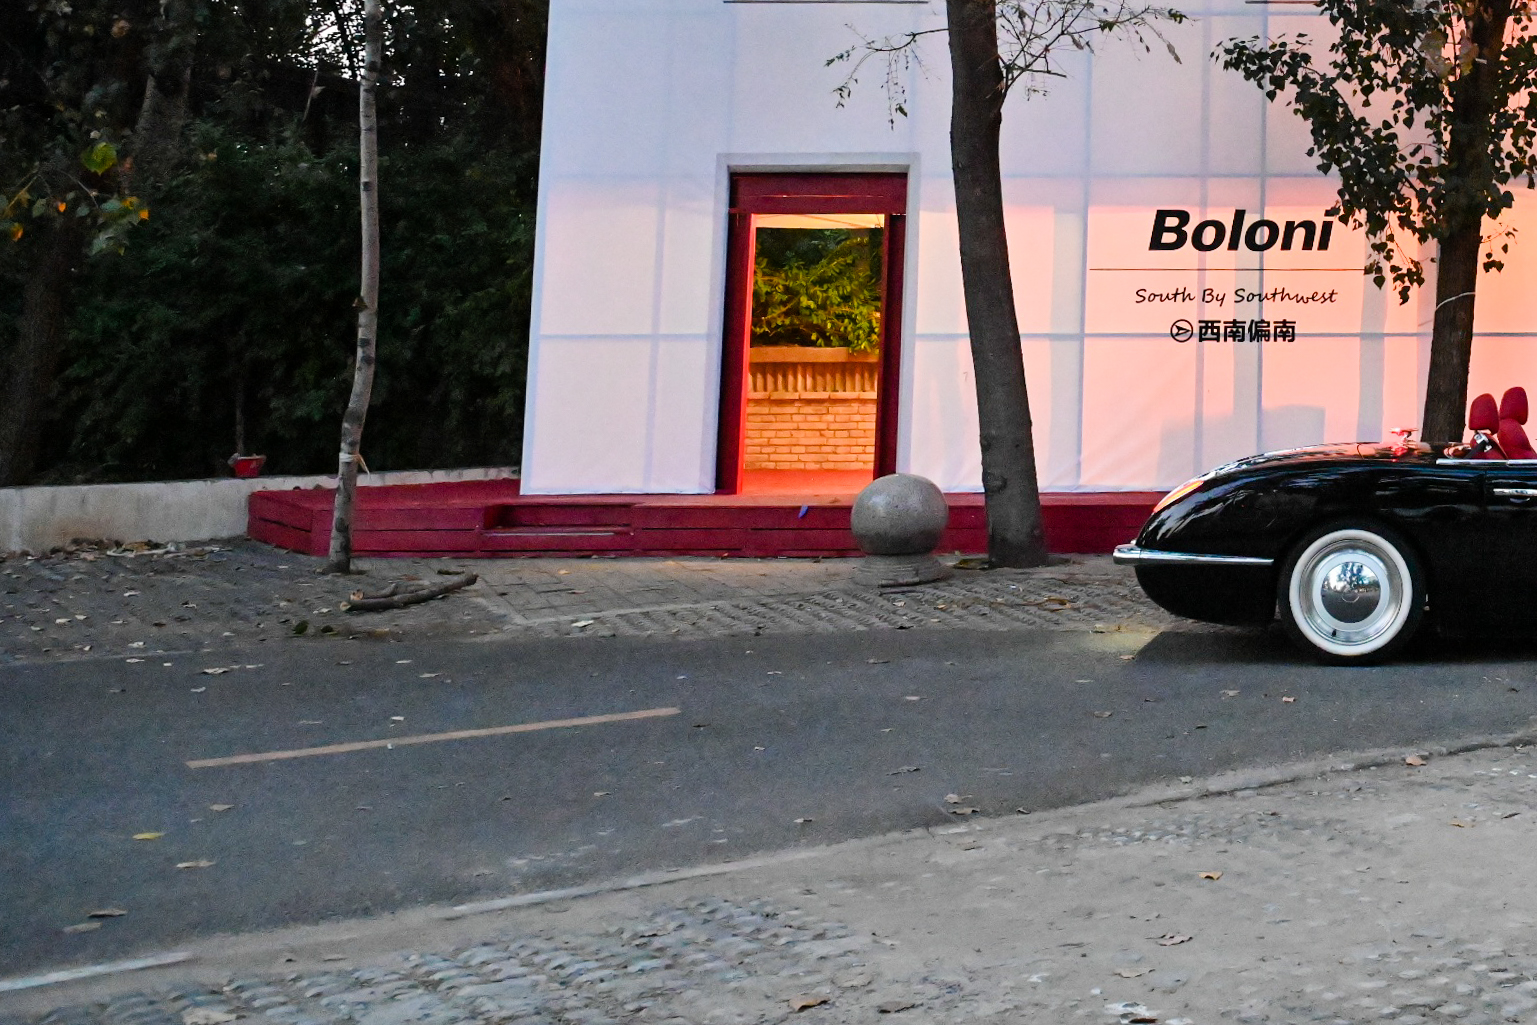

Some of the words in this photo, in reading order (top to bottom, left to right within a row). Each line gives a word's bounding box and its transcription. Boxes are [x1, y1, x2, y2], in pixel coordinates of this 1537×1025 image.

[1148, 209, 1336, 252] Boloni
[1135, 287, 1195, 304] South
[1201, 288, 1226, 307] By
[1233, 287, 1338, 305] Southwest
[1197, 318, 1296, 343] 西南偏南
